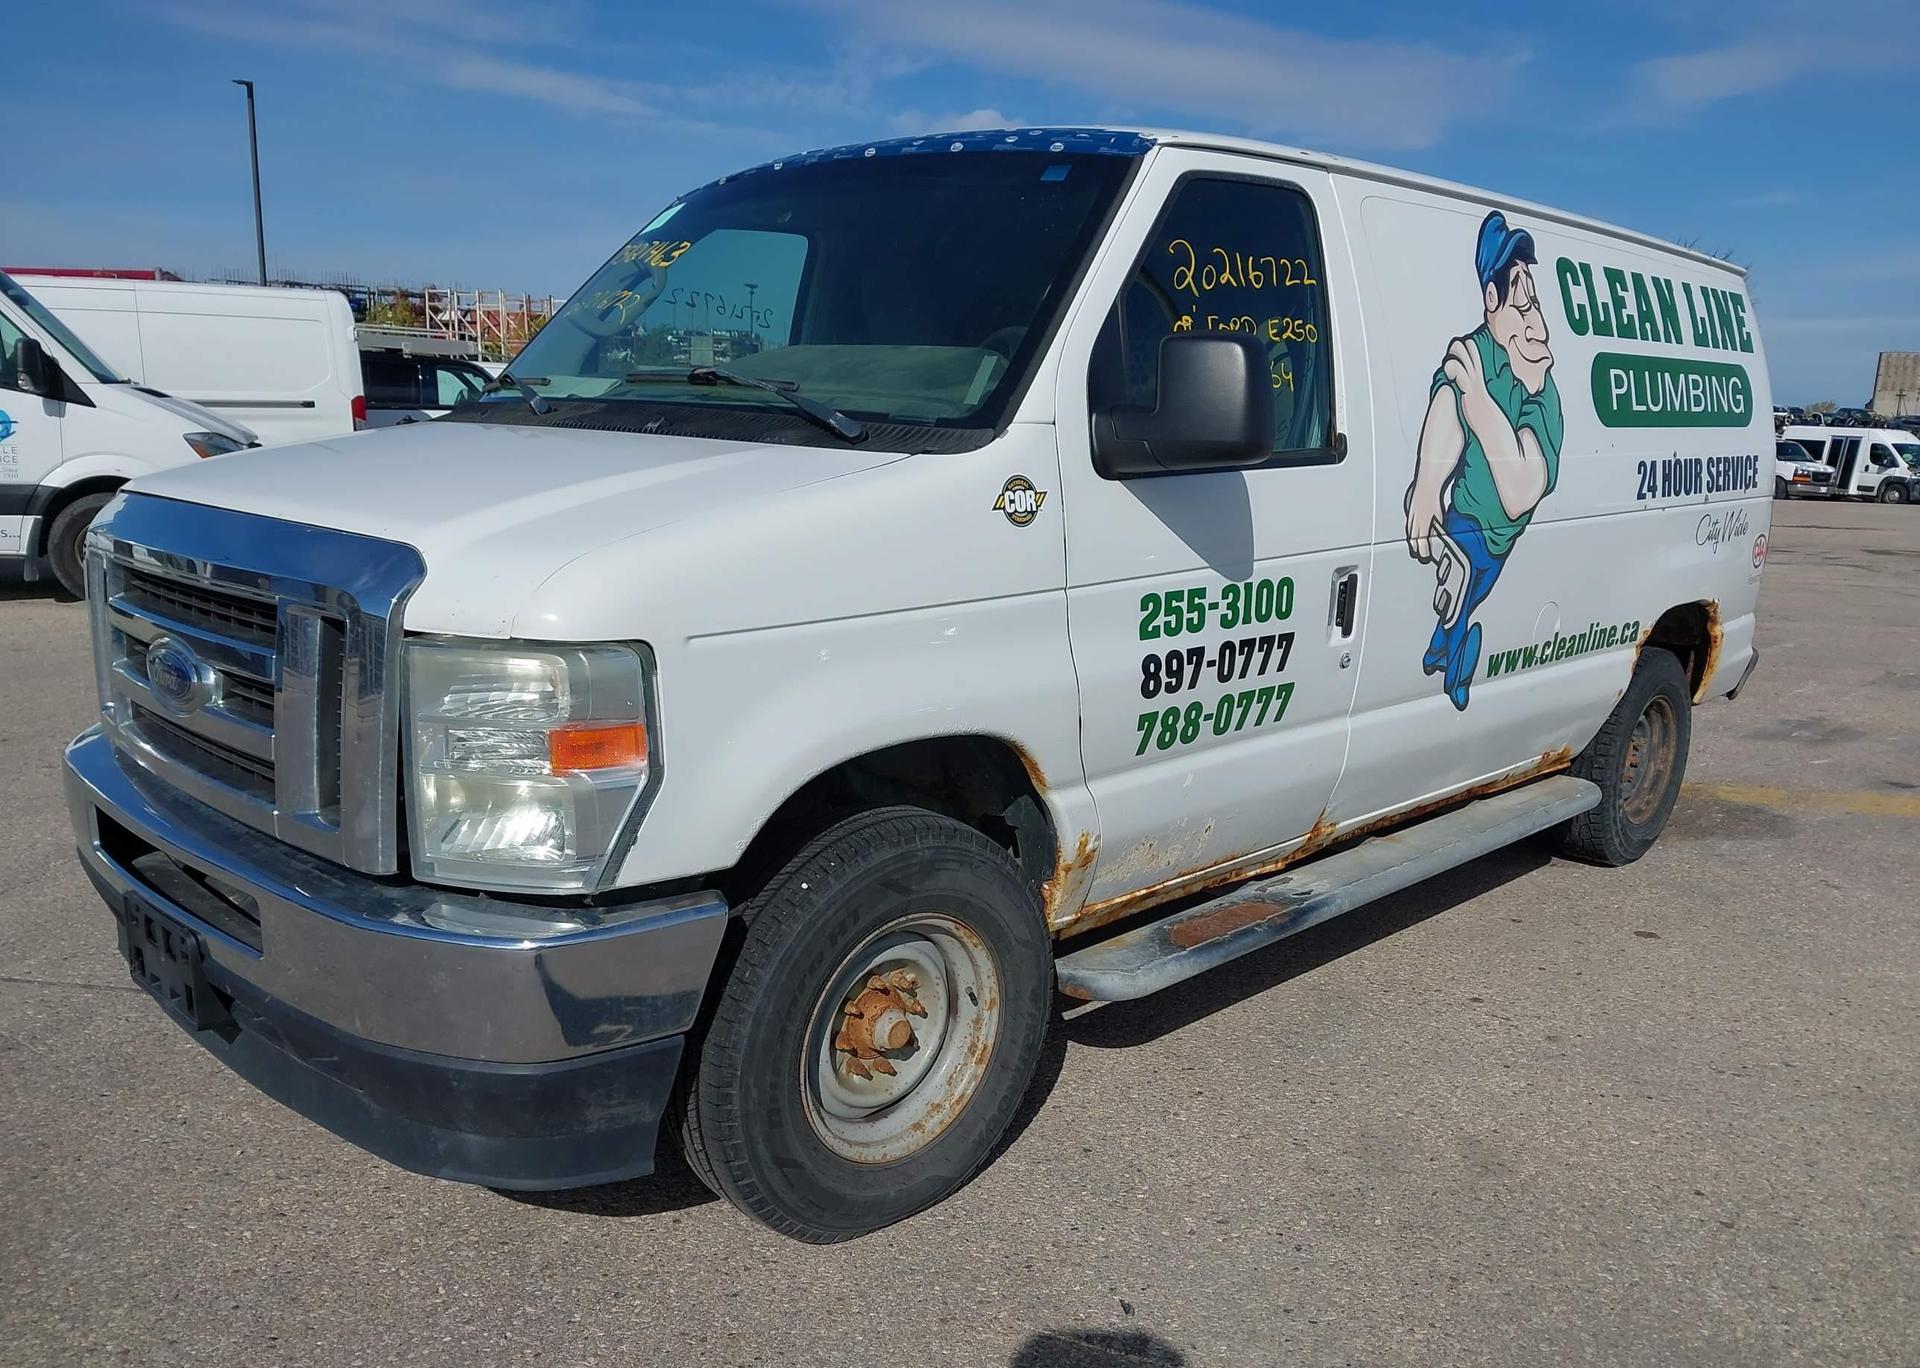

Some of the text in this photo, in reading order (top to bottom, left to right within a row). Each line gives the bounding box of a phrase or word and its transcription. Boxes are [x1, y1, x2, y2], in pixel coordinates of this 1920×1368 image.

[1168, 239, 1317, 297] 20216722
[1267, 317, 1318, 343] E250
[1556, 256, 1755, 354] CLEAN LINE
[1609, 368, 1745, 414] PLUMBING
[1004, 489, 1037, 513] COR
[1636, 455, 1759, 501] 24 HOUR SERVICE
[1695, 513, 1721, 555] City
[1722, 508, 1749, 543] Wide
[1139, 576, 1295, 641] 255-3100
[1140, 632, 1296, 699] 897-0777
[1486, 620, 1641, 678] www.cleanline.ca
[1135, 681, 1296, 757] 788-0777
